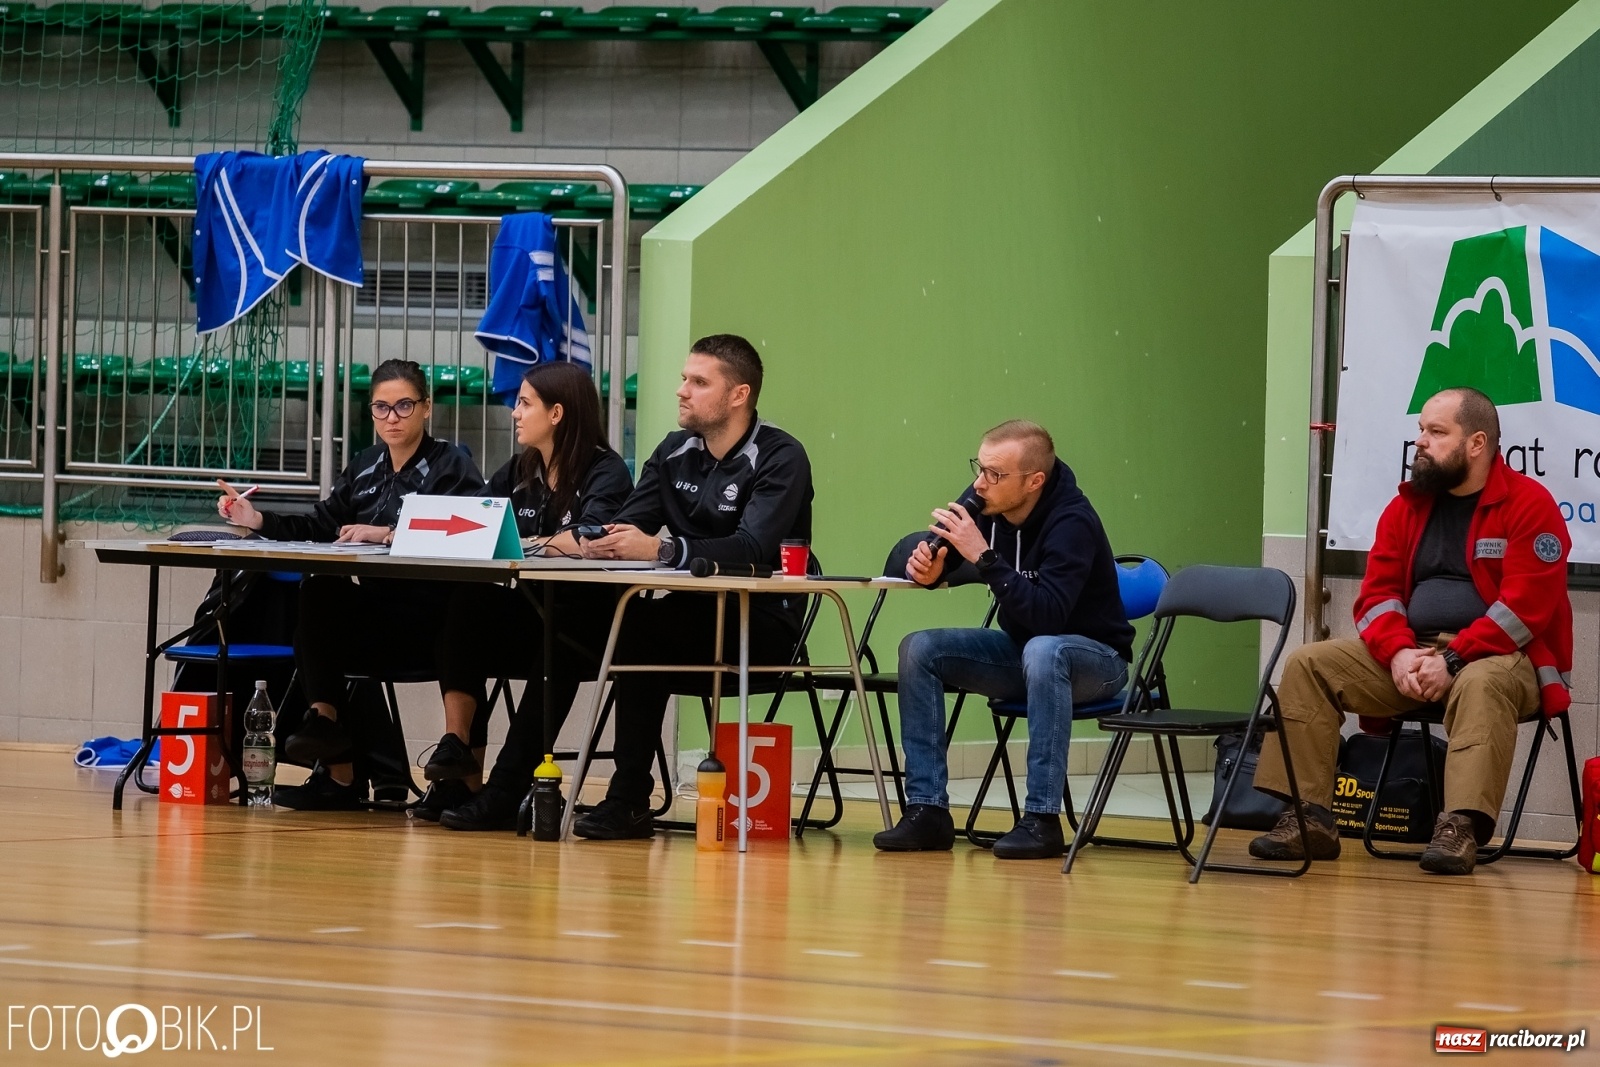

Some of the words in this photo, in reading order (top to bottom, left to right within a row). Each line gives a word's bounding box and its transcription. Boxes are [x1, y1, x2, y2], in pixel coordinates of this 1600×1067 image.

[1401, 438, 1546, 482] pat
[167, 705, 199, 776] 5
[728, 736, 777, 808] 5
[1335, 777, 1357, 797] 3D
[1348, 819, 1365, 828] Wynik
[1375, 822, 1409, 833] Sportowych
